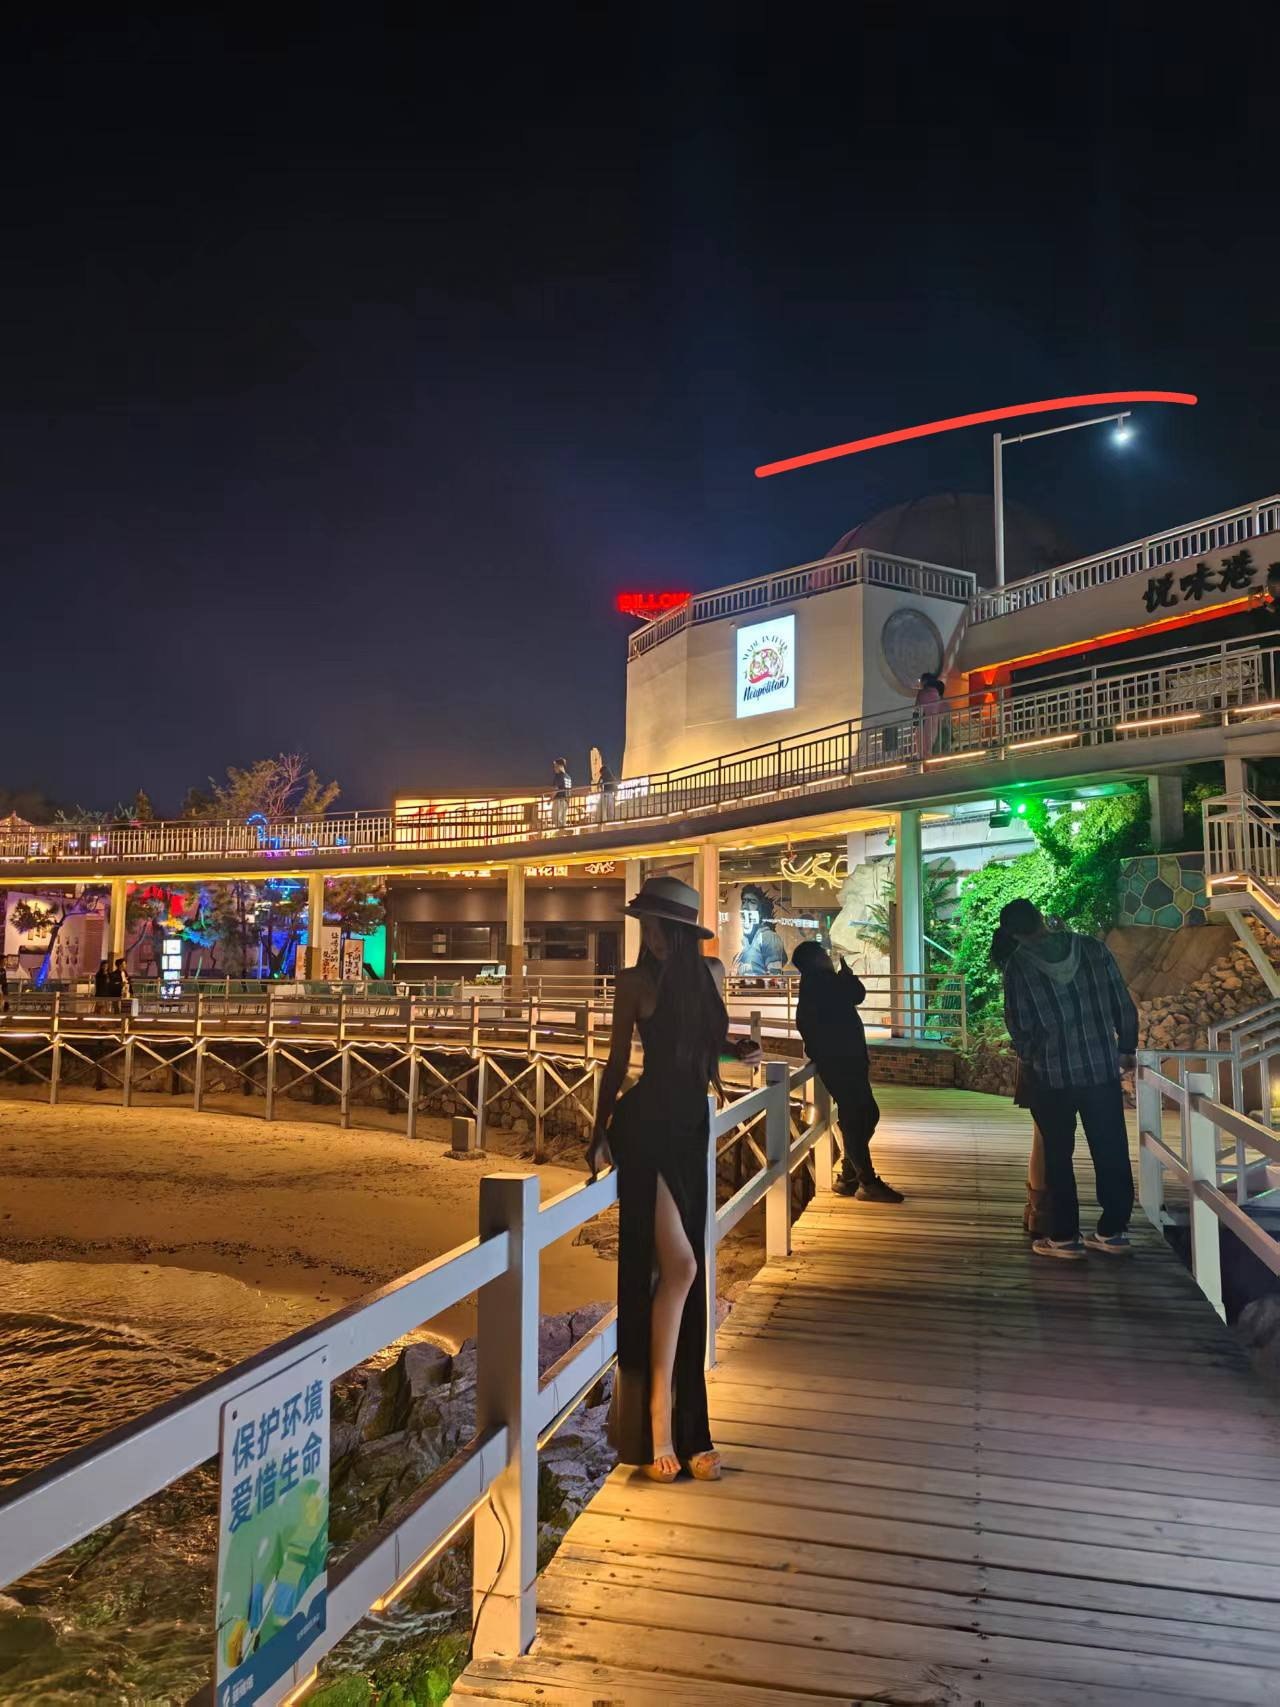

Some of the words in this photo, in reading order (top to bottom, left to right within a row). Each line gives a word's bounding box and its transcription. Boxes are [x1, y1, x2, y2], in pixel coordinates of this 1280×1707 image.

[231, 1379, 323, 1476] 保护环境
[229, 1431, 322, 1534] 爱惜生命
